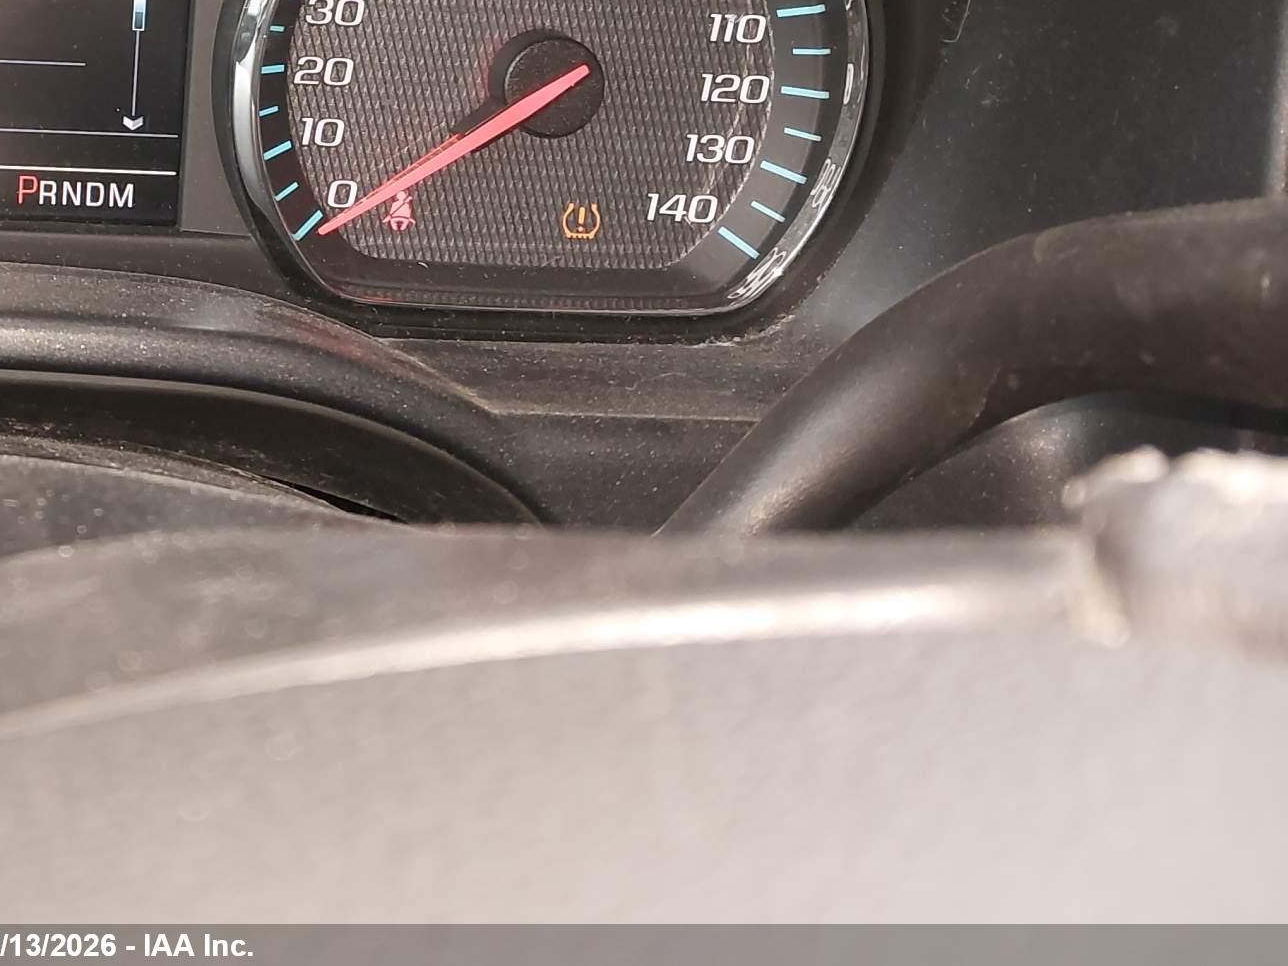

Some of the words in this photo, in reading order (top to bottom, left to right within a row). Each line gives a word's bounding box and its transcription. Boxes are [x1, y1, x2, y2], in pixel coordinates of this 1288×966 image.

[708, 13, 767, 44] 110
[292, 56, 354, 87] 20
[699, 73, 771, 105] 120
[301, 118, 345, 148] 10
[685, 134, 755, 165] 130
[15, 174, 135, 209] PRNDM
[327, 180, 358, 209] 0
[646, 192, 718, 224] 140
